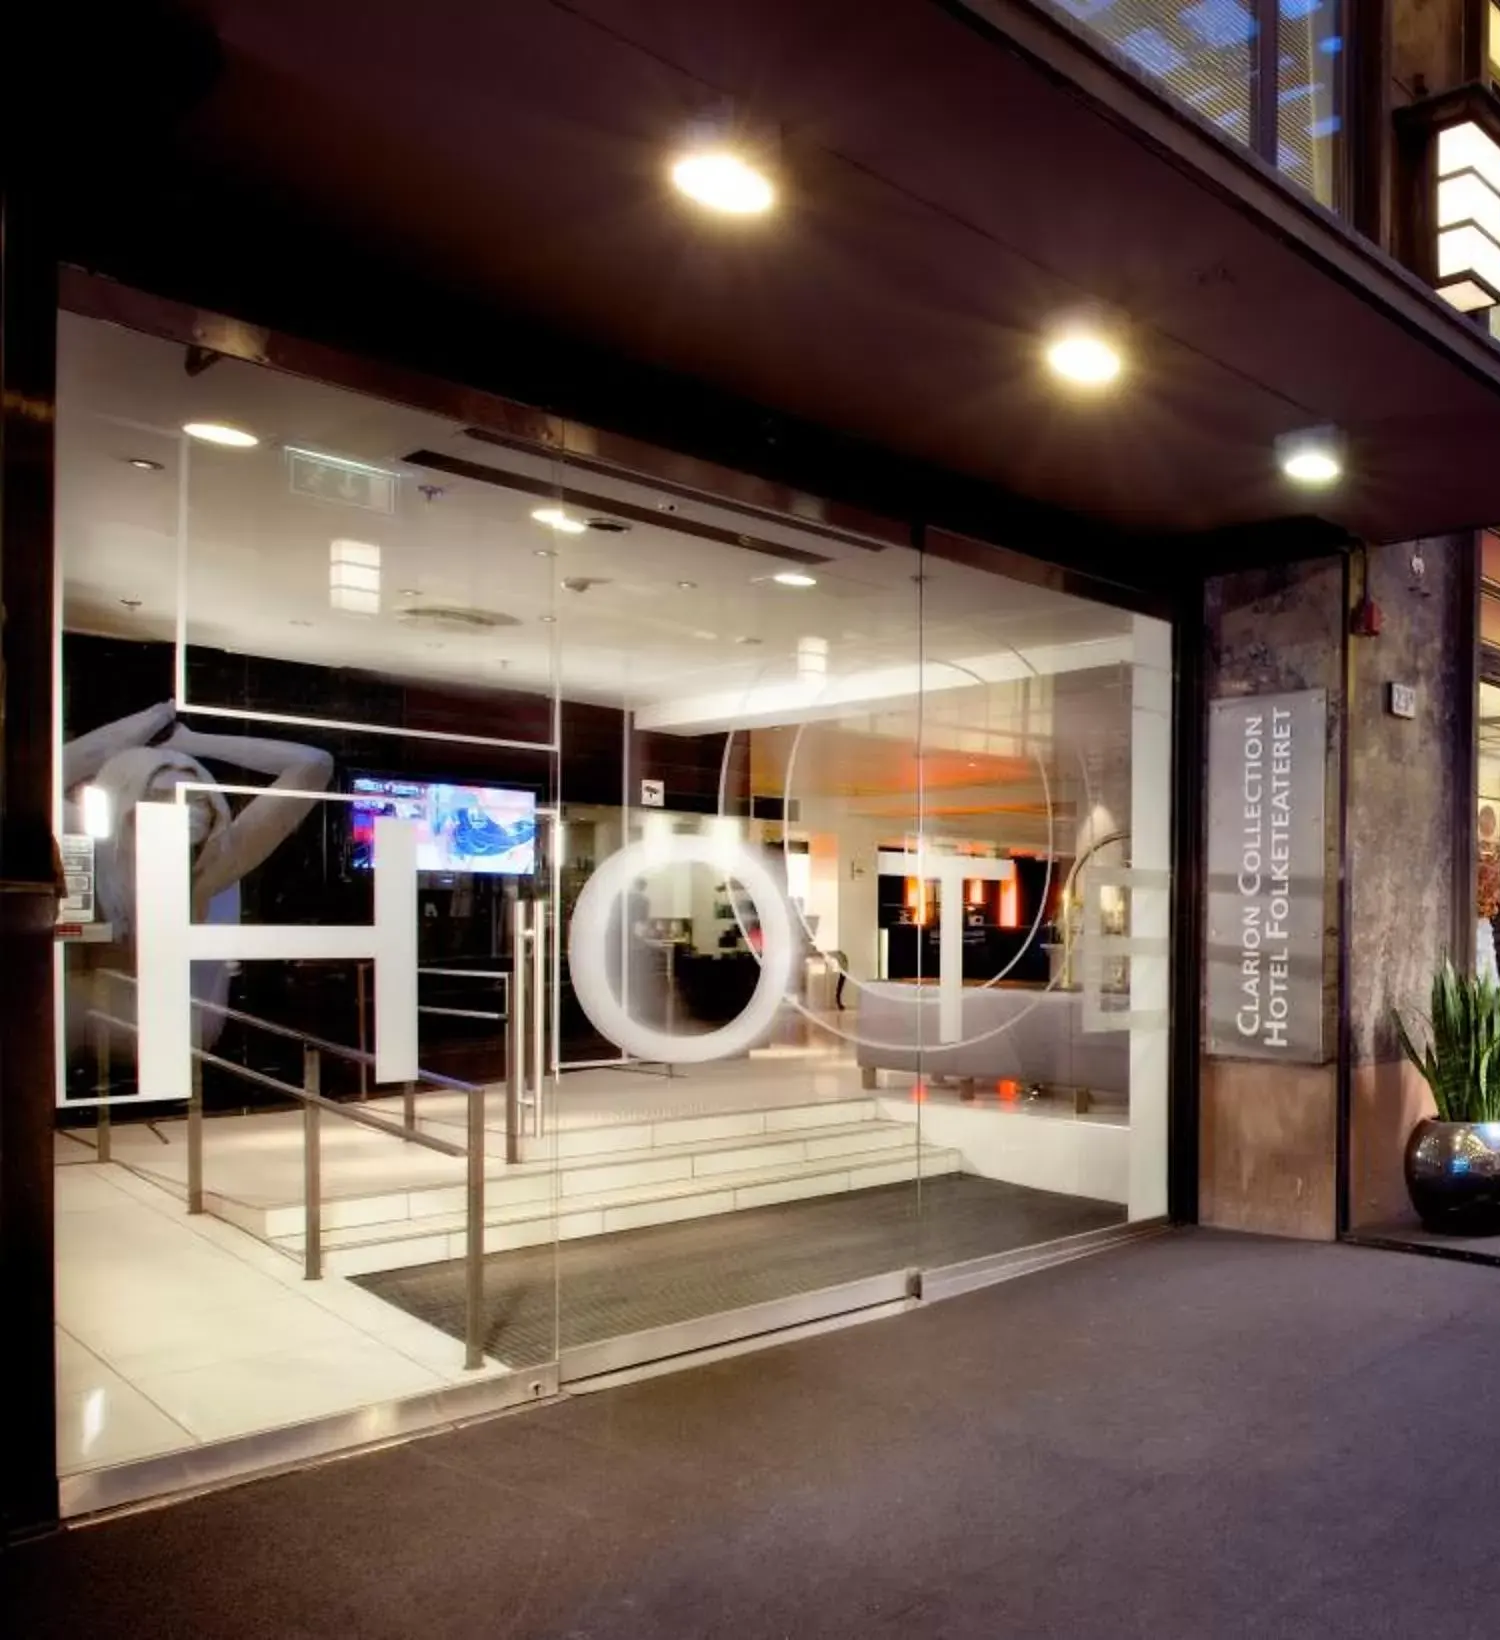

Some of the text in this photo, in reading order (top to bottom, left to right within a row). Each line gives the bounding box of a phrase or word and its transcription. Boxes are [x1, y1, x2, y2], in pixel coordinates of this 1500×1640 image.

[1236, 715, 1263, 1036] CLARION COLLECTION
[1263, 706, 1293, 1048] HOTEL FOLKETEATERET
